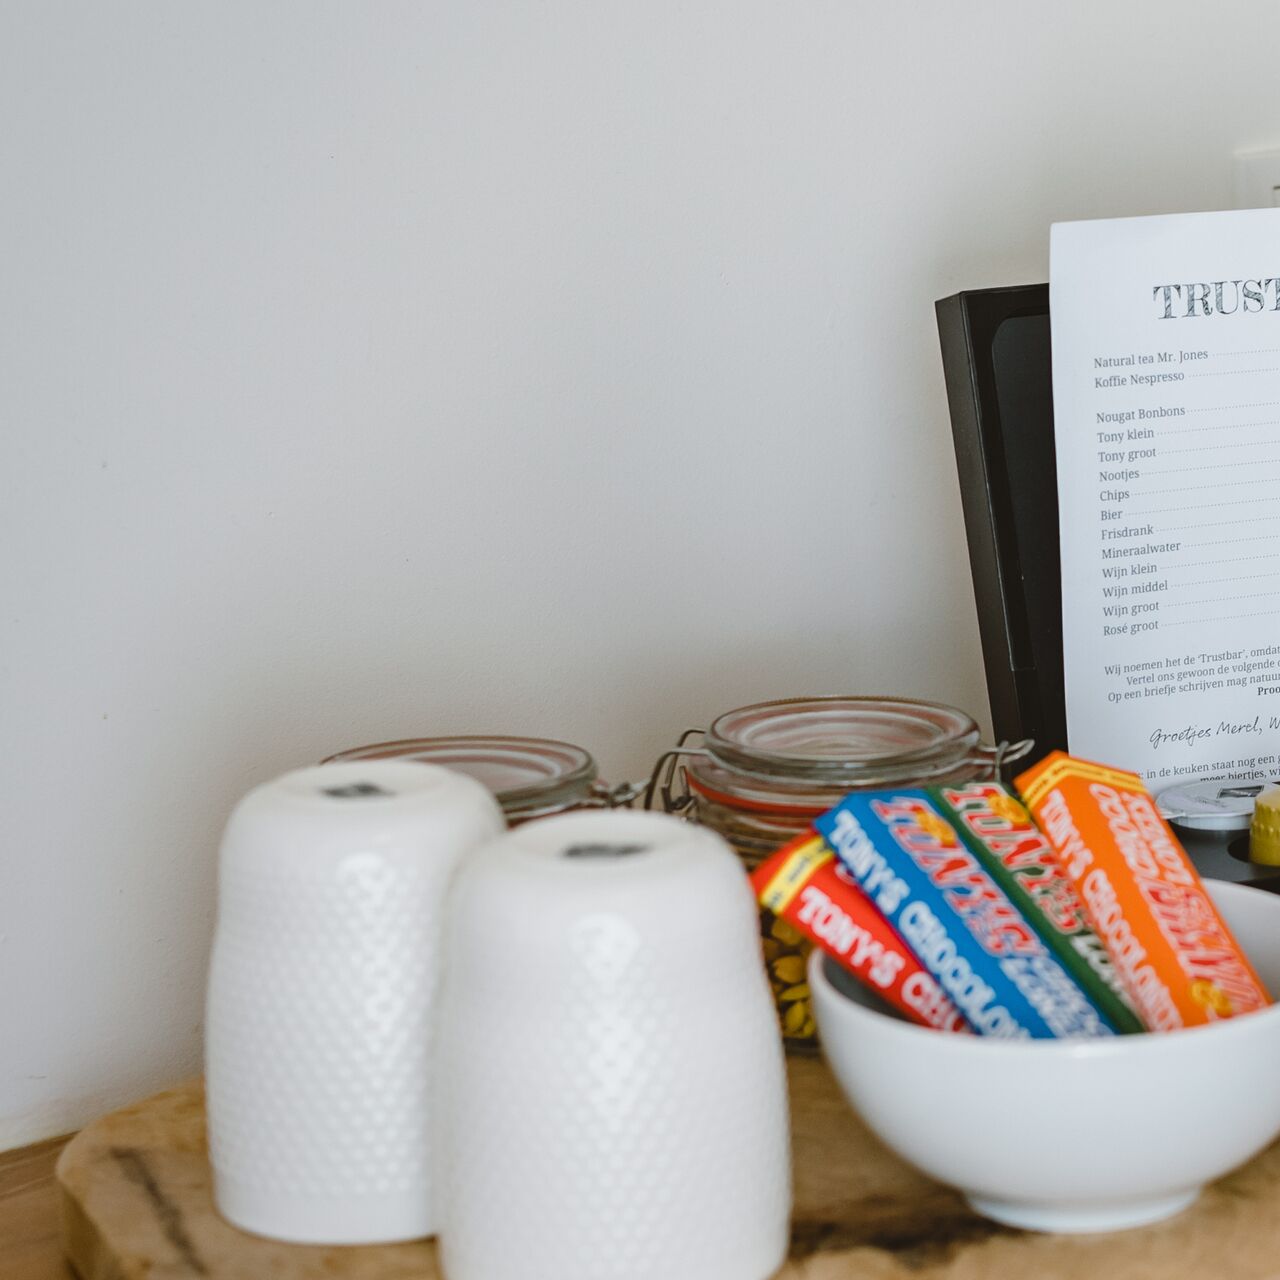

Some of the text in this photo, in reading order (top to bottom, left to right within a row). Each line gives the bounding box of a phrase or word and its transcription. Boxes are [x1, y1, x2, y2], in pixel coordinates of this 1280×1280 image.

[1094, 355, 1135, 368] Natural
[1138, 355, 1154, 365] tea
[1157, 352, 1177, 364] Mr.
[1179, 350, 1208, 364] Jones
[1094, 375, 1128, 388] Koffie
[1130, 372, 1185, 386] Nespresso
[1096, 410, 1136, 424] Nougat
[1138, 406, 1186, 420] Bonbons
[1096, 431, 1124, 444] Tony
[1127, 428, 1155, 440] klein
[1098, 451, 1126, 464] Tony
[1128, 448, 1157, 462] groot
[1099, 468, 1140, 482] Nootjes
[1100, 489, 1130, 502] Chips
[1100, 509, 1124, 521] Bier
[1101, 524, 1154, 540] Frisdrank
[1102, 542, 1182, 560] Mineraalwater
[1102, 566, 1128, 580] Wijn
[1130, 562, 1158, 576] klein
[1102, 586, 1128, 599] Wijn
[1131, 580, 1168, 594] middel
[1102, 604, 1128, 618] Wijn
[1130, 602, 1160, 616] groot
[1103, 622, 1128, 636] Rosé
[1130, 620, 1160, 636] groot
[1104, 664, 1122, 677] Wij
[1124, 661, 1163, 673] noemen
[1166, 658, 1181, 668] het
[1184, 655, 1196, 666] de
[1250, 644, 1280, 658] omdat
[1126, 673, 1156, 686] Vertel
[1158, 672, 1175, 682] ons
[1177, 667, 1215, 682] gewoon
[1217, 664, 1230, 675] de
[1232, 658, 1275, 674] volgende
[1108, 692, 1122, 704] Op
[1124, 690, 1142, 700] een
[1144, 684, 1176, 698] briefje
[1178, 680, 1224, 694] schrijven
[1226, 676, 1248, 688] mag
[1149, 725, 1212, 750] Groetjes
[1146, 768, 1156, 780] in
[1159, 767, 1171, 778] de
[1173, 762, 1210, 776] keuken
[1211, 759, 1235, 772] staat
[1237, 756, 1256, 770] nog
[1258, 754, 1275, 766] een
[798, 885, 906, 989] TONY'S
